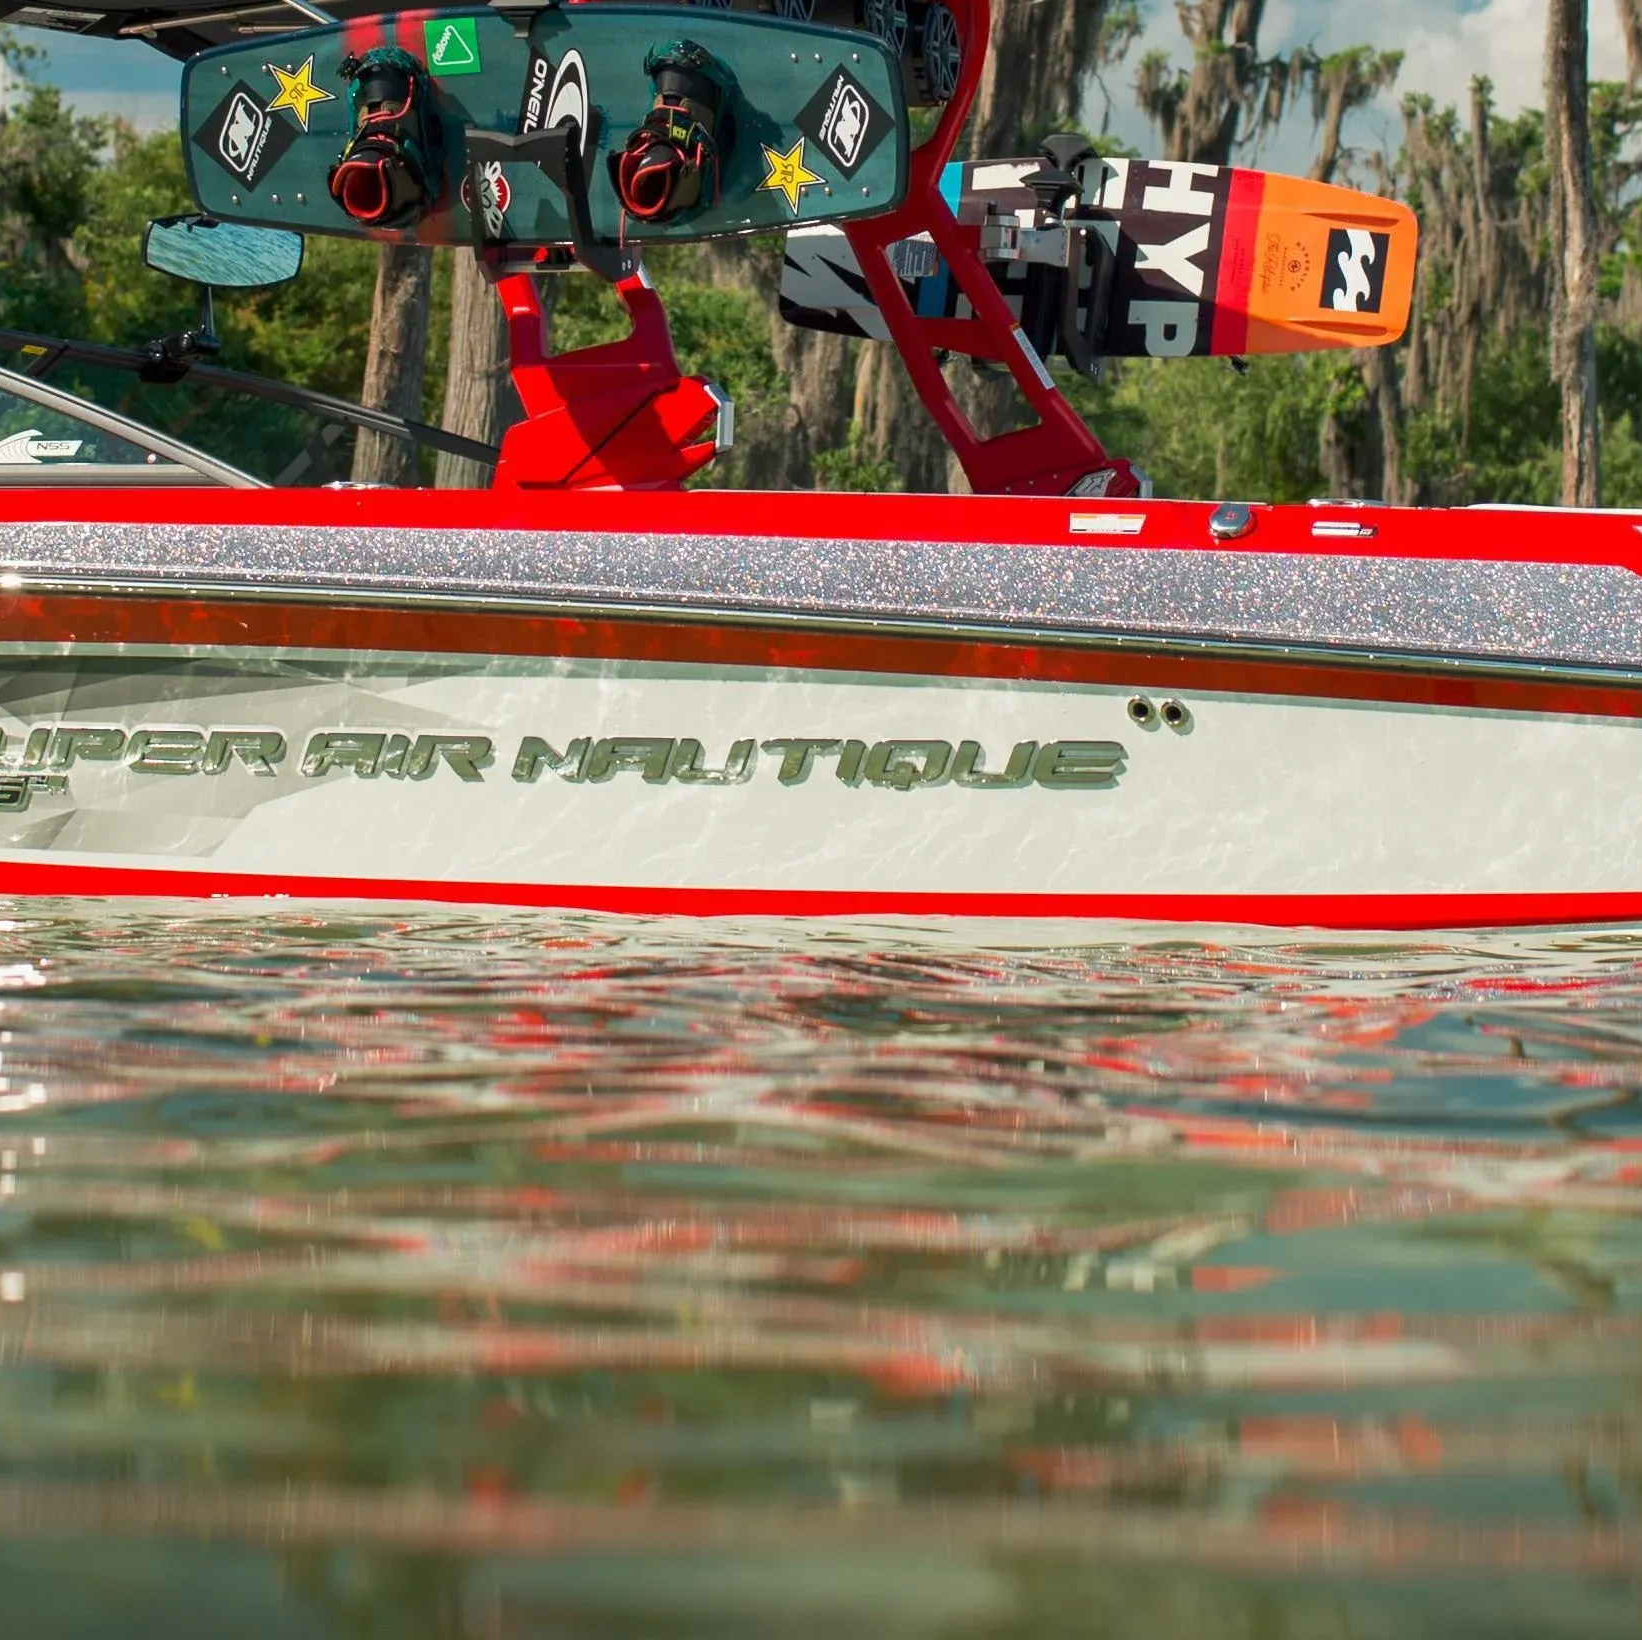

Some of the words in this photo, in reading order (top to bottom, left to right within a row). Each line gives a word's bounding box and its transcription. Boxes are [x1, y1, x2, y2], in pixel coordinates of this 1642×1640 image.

[524, 58, 548, 135] O'NEIL
[818, 74, 845, 142] NAUTIQUE
[246, 115, 273, 182] NAUTIQUE
[302, 730, 495, 782] AIR
[512, 735, 1129, 791] NAUTIQUE
